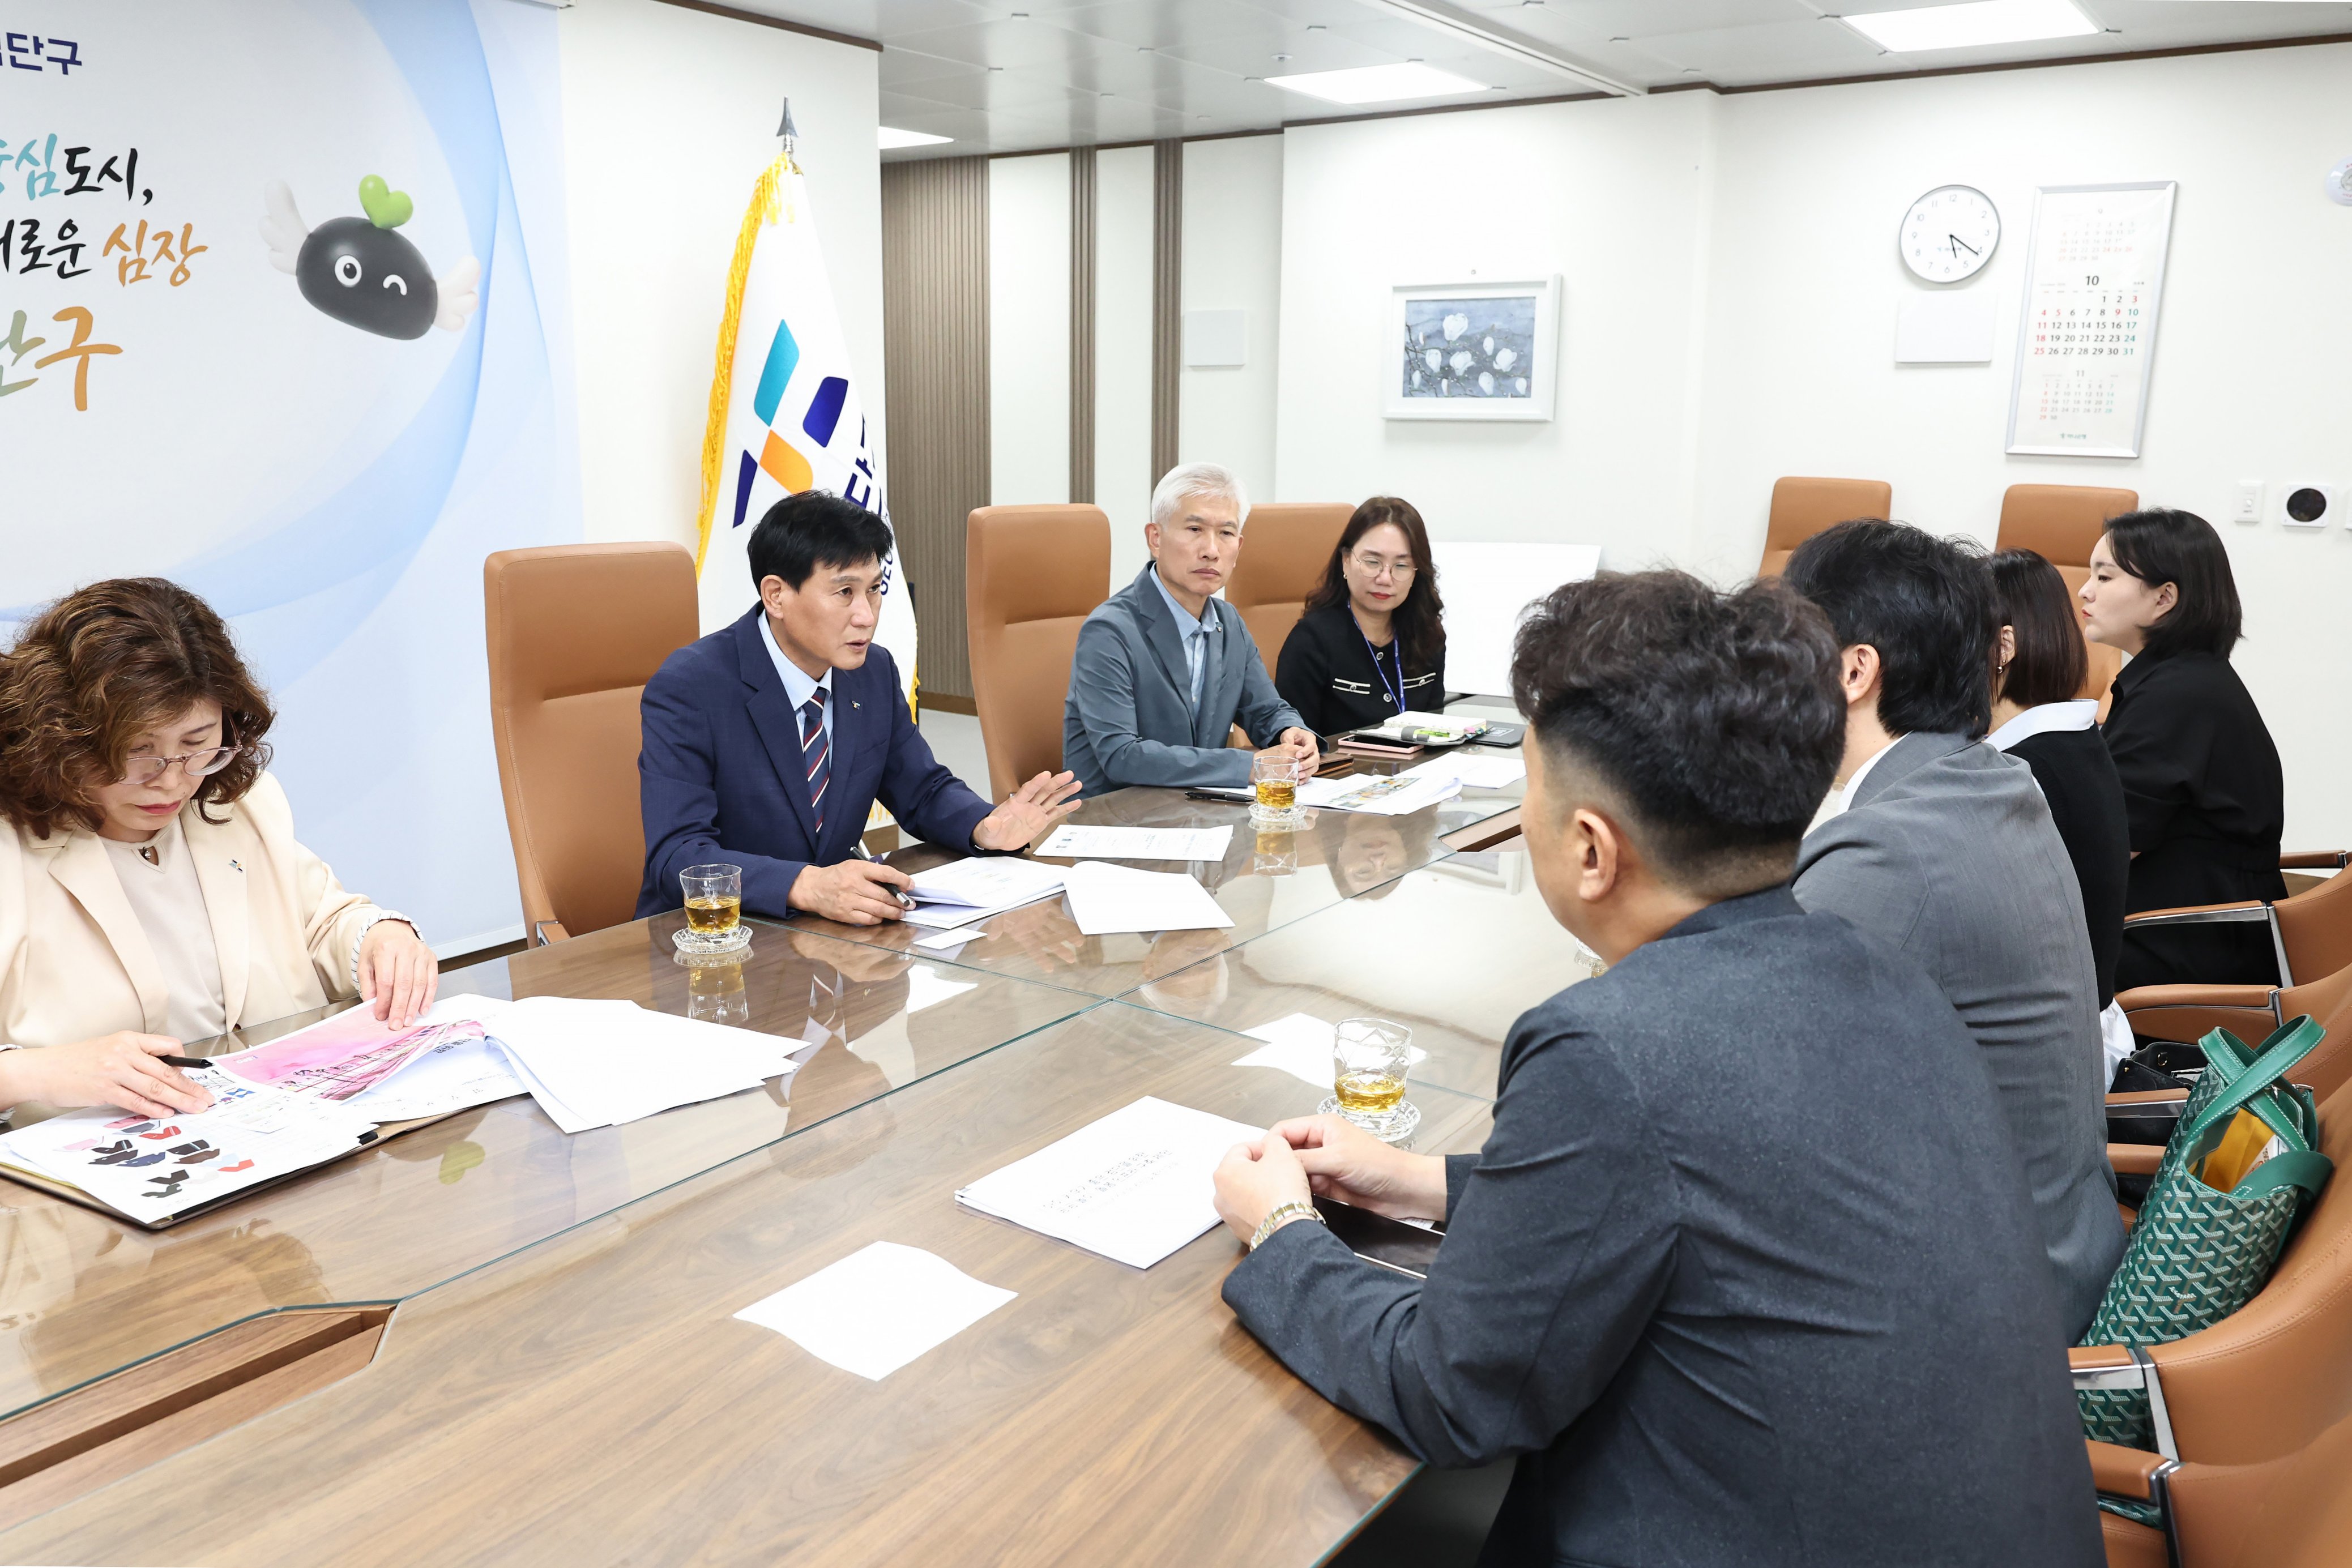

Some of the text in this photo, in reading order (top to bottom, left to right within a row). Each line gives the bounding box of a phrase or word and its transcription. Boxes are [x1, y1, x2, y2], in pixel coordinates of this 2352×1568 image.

[0, 32, 82, 75] 단구
[103, 219, 208, 288] 심장
[2086, 276, 2099, 285] 10
